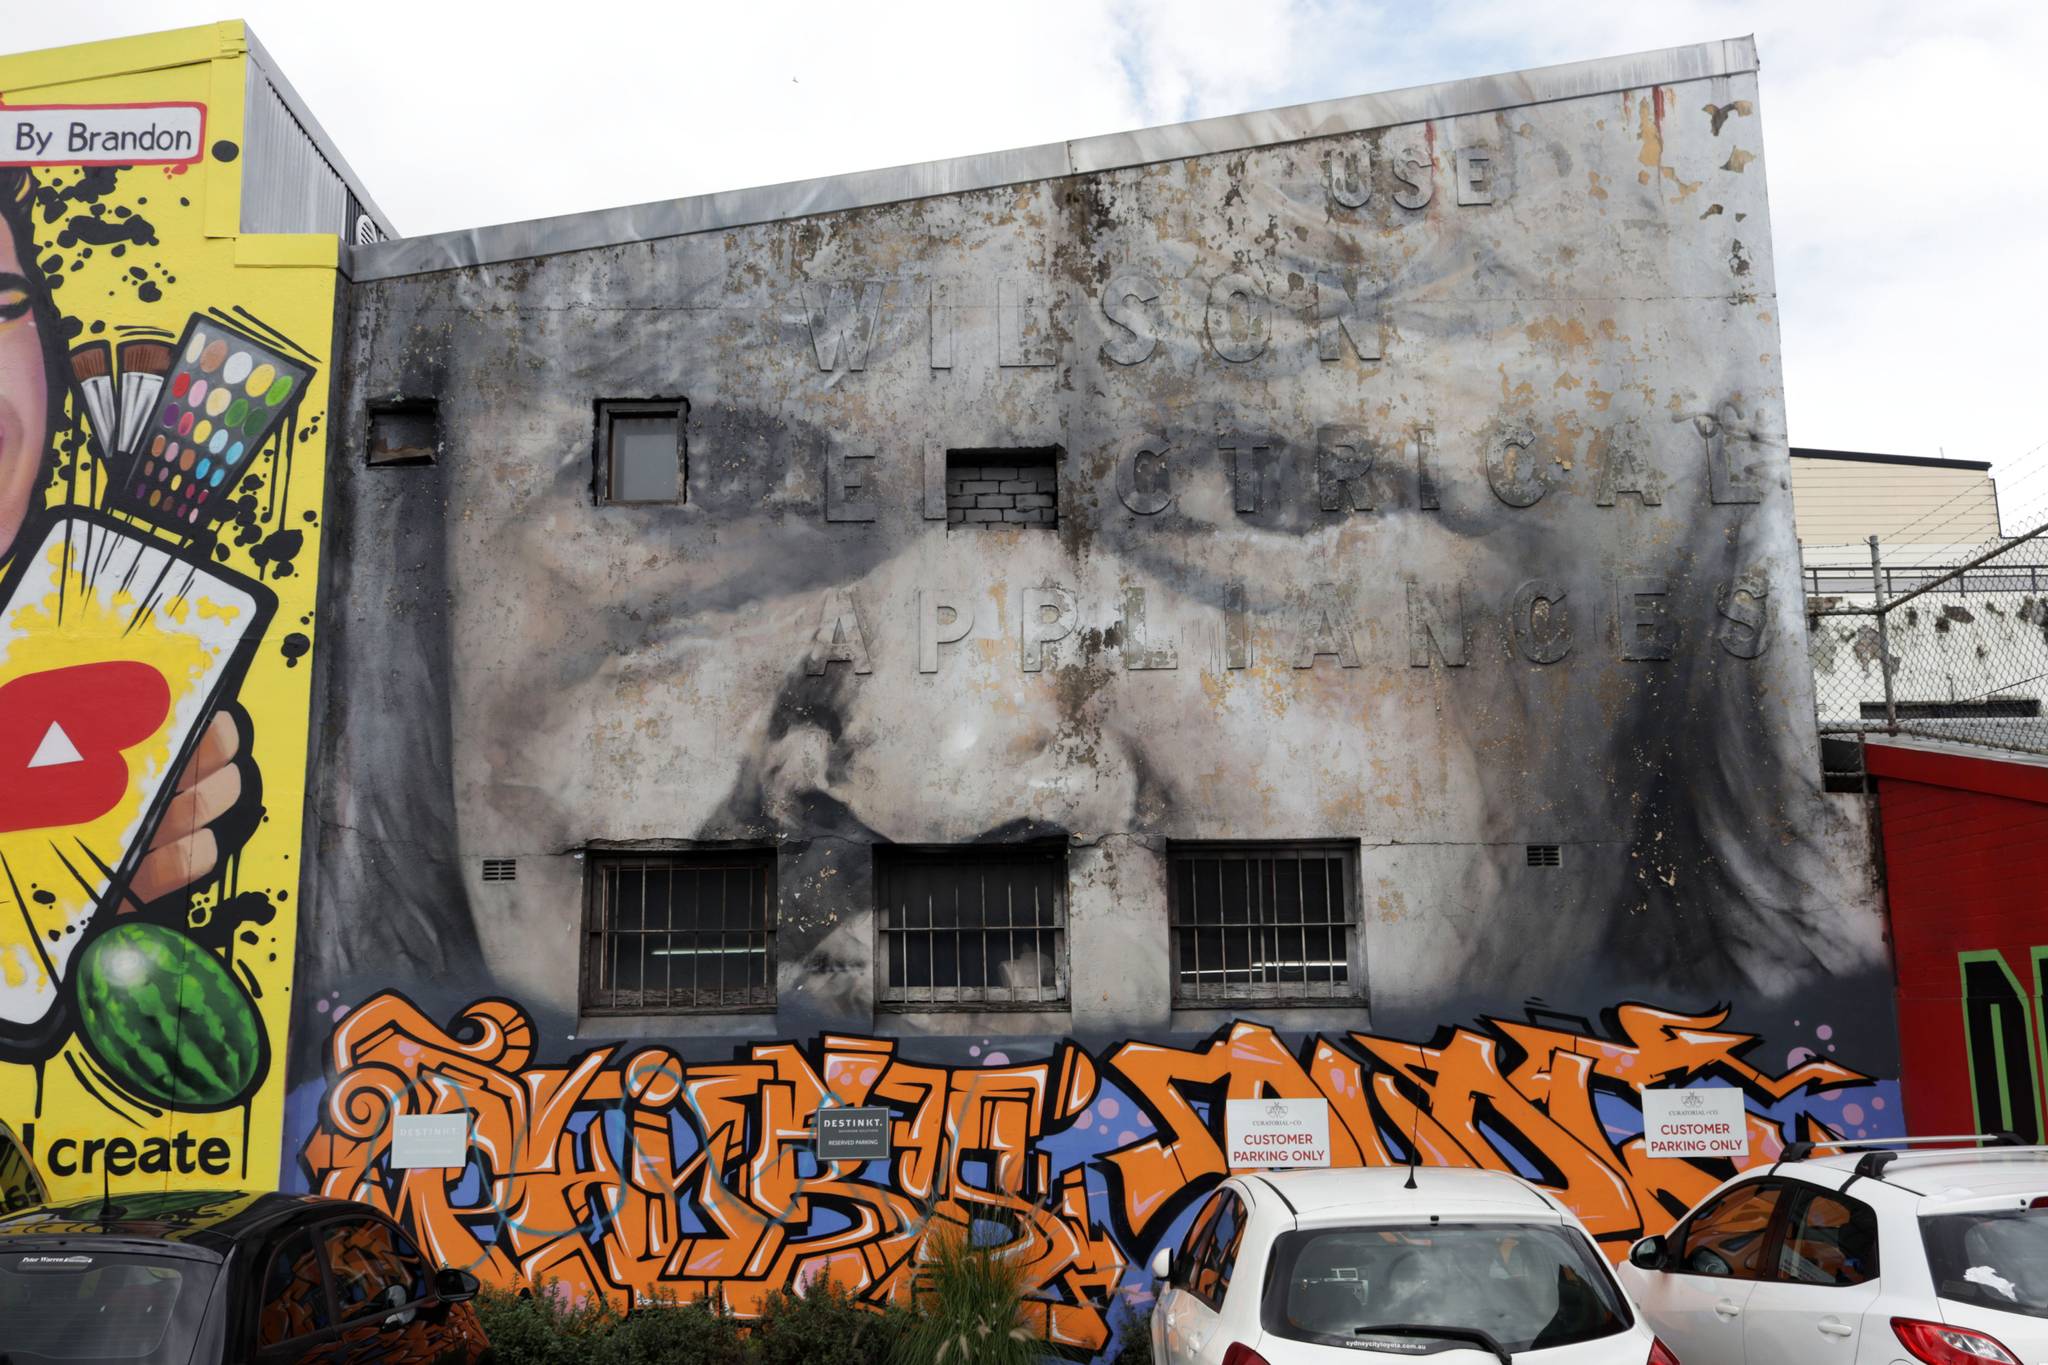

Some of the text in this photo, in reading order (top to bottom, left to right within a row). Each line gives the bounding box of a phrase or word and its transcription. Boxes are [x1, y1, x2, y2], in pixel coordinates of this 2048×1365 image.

[16, 121, 192, 156] By Brandon
[1329, 145, 1492, 209] USE
[800, 273, 1381, 372] WILSON
[807, 577, 1774, 676] APPLIANCES
[1244, 1133, 1313, 1146] CUSTOMER
[1651, 1139, 1742, 1152] PARKING ONLY
[1660, 1123, 1730, 1135] CUSTOMER
[47, 1130, 231, 1177] create
[1233, 1150, 1325, 1162] PARKING ONLY
